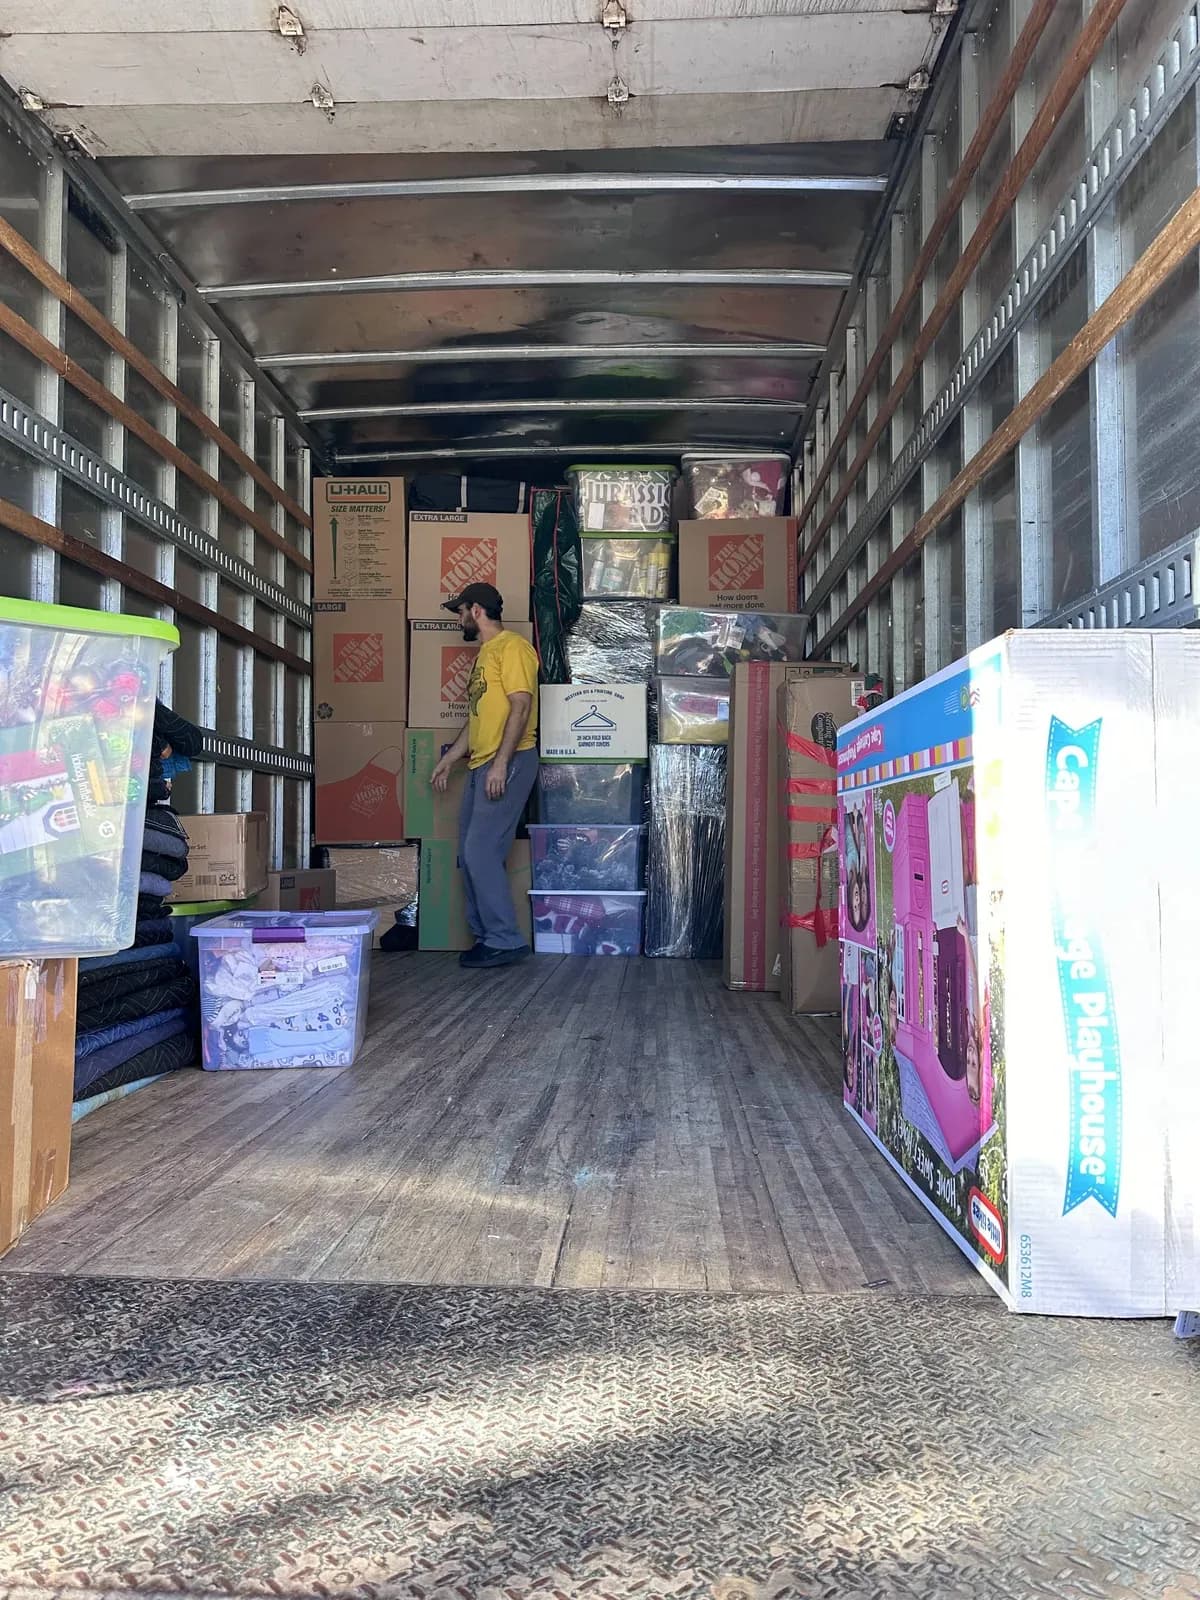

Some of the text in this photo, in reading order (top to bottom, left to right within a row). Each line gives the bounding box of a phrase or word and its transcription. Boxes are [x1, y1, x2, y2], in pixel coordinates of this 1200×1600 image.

[330, 485, 387, 495] U-HAUL
[330, 505, 386, 513] SIZE MATTERS!
[440, 514, 465, 522] LARGE
[441, 537, 497, 592] HOME
[446, 543, 470, 565] THE
[709, 535, 764, 590] HOME
[713, 541, 737, 561] THE
[730, 553, 763, 588] DEPOT
[736, 593, 758, 601] doors
[334, 633, 384, 681] HOME
[339, 639, 360, 657] THE
[446, 652, 470, 674] THE
[816, 713, 825, 744] Company
[825, 712, 833, 738] Sterling
[72, 753, 87, 782] Holiday
[1066, 991, 1120, 1177] Playhouse
[913, 1148, 934, 1190] SWEET
[936, 1169, 957, 1208] HOME
[1020, 1234, 1032, 1298] 653612M8
